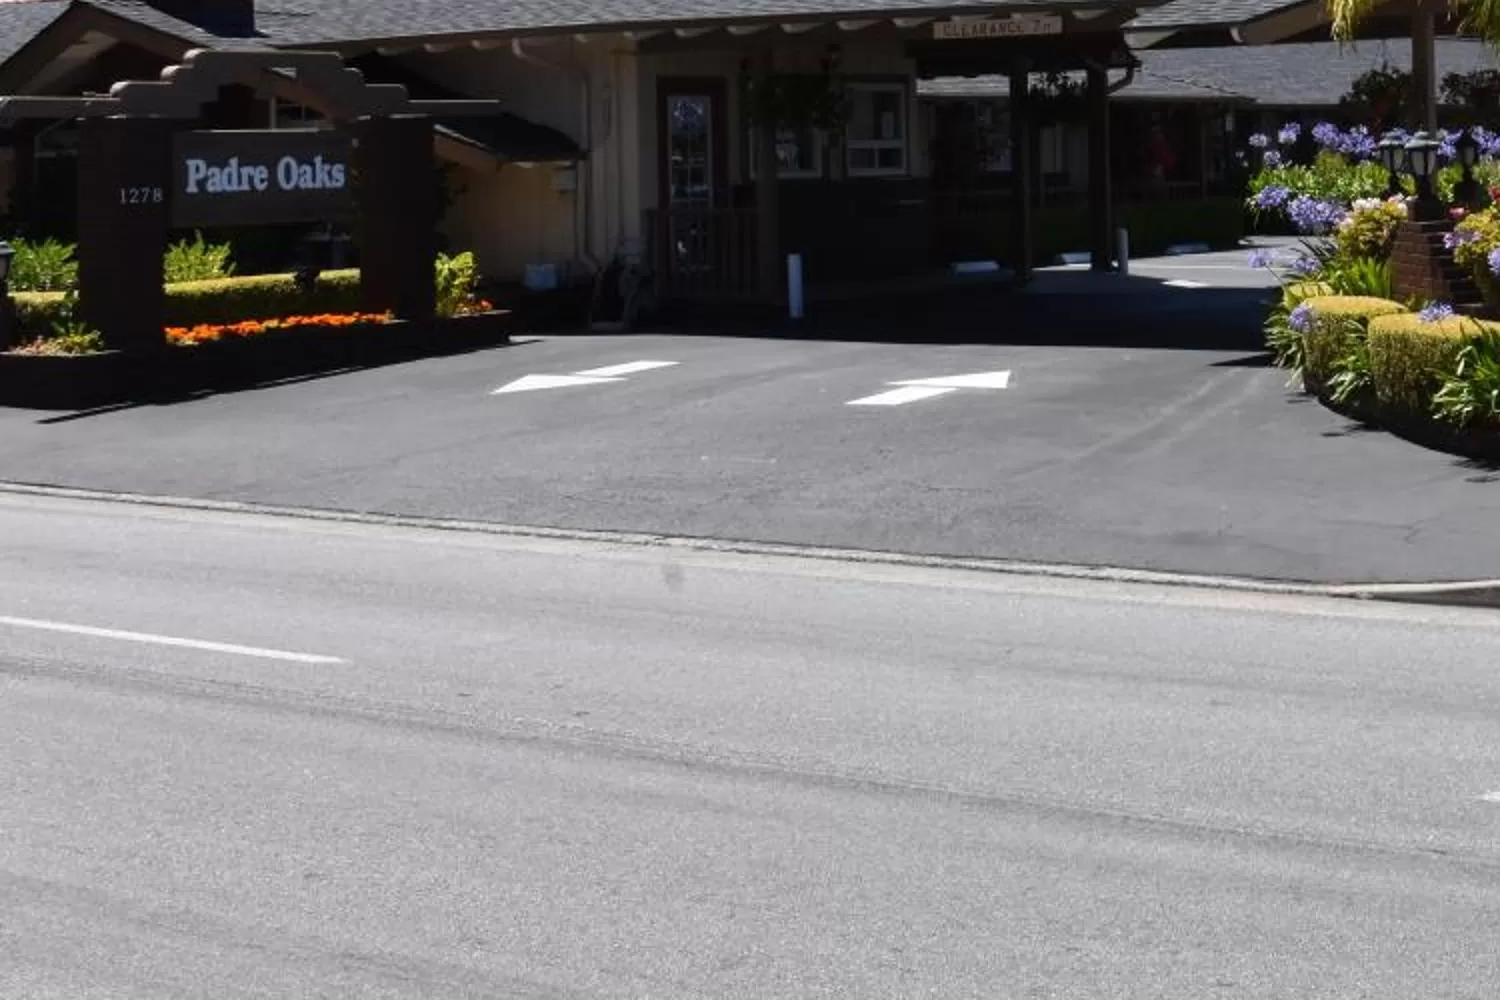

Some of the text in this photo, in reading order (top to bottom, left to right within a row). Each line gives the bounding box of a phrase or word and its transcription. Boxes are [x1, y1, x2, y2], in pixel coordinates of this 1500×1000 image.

[943, 21, 1025, 37] CLEARANCE
[185, 155, 346, 193] Padre Oaks
[120, 186, 164, 204] 1278
